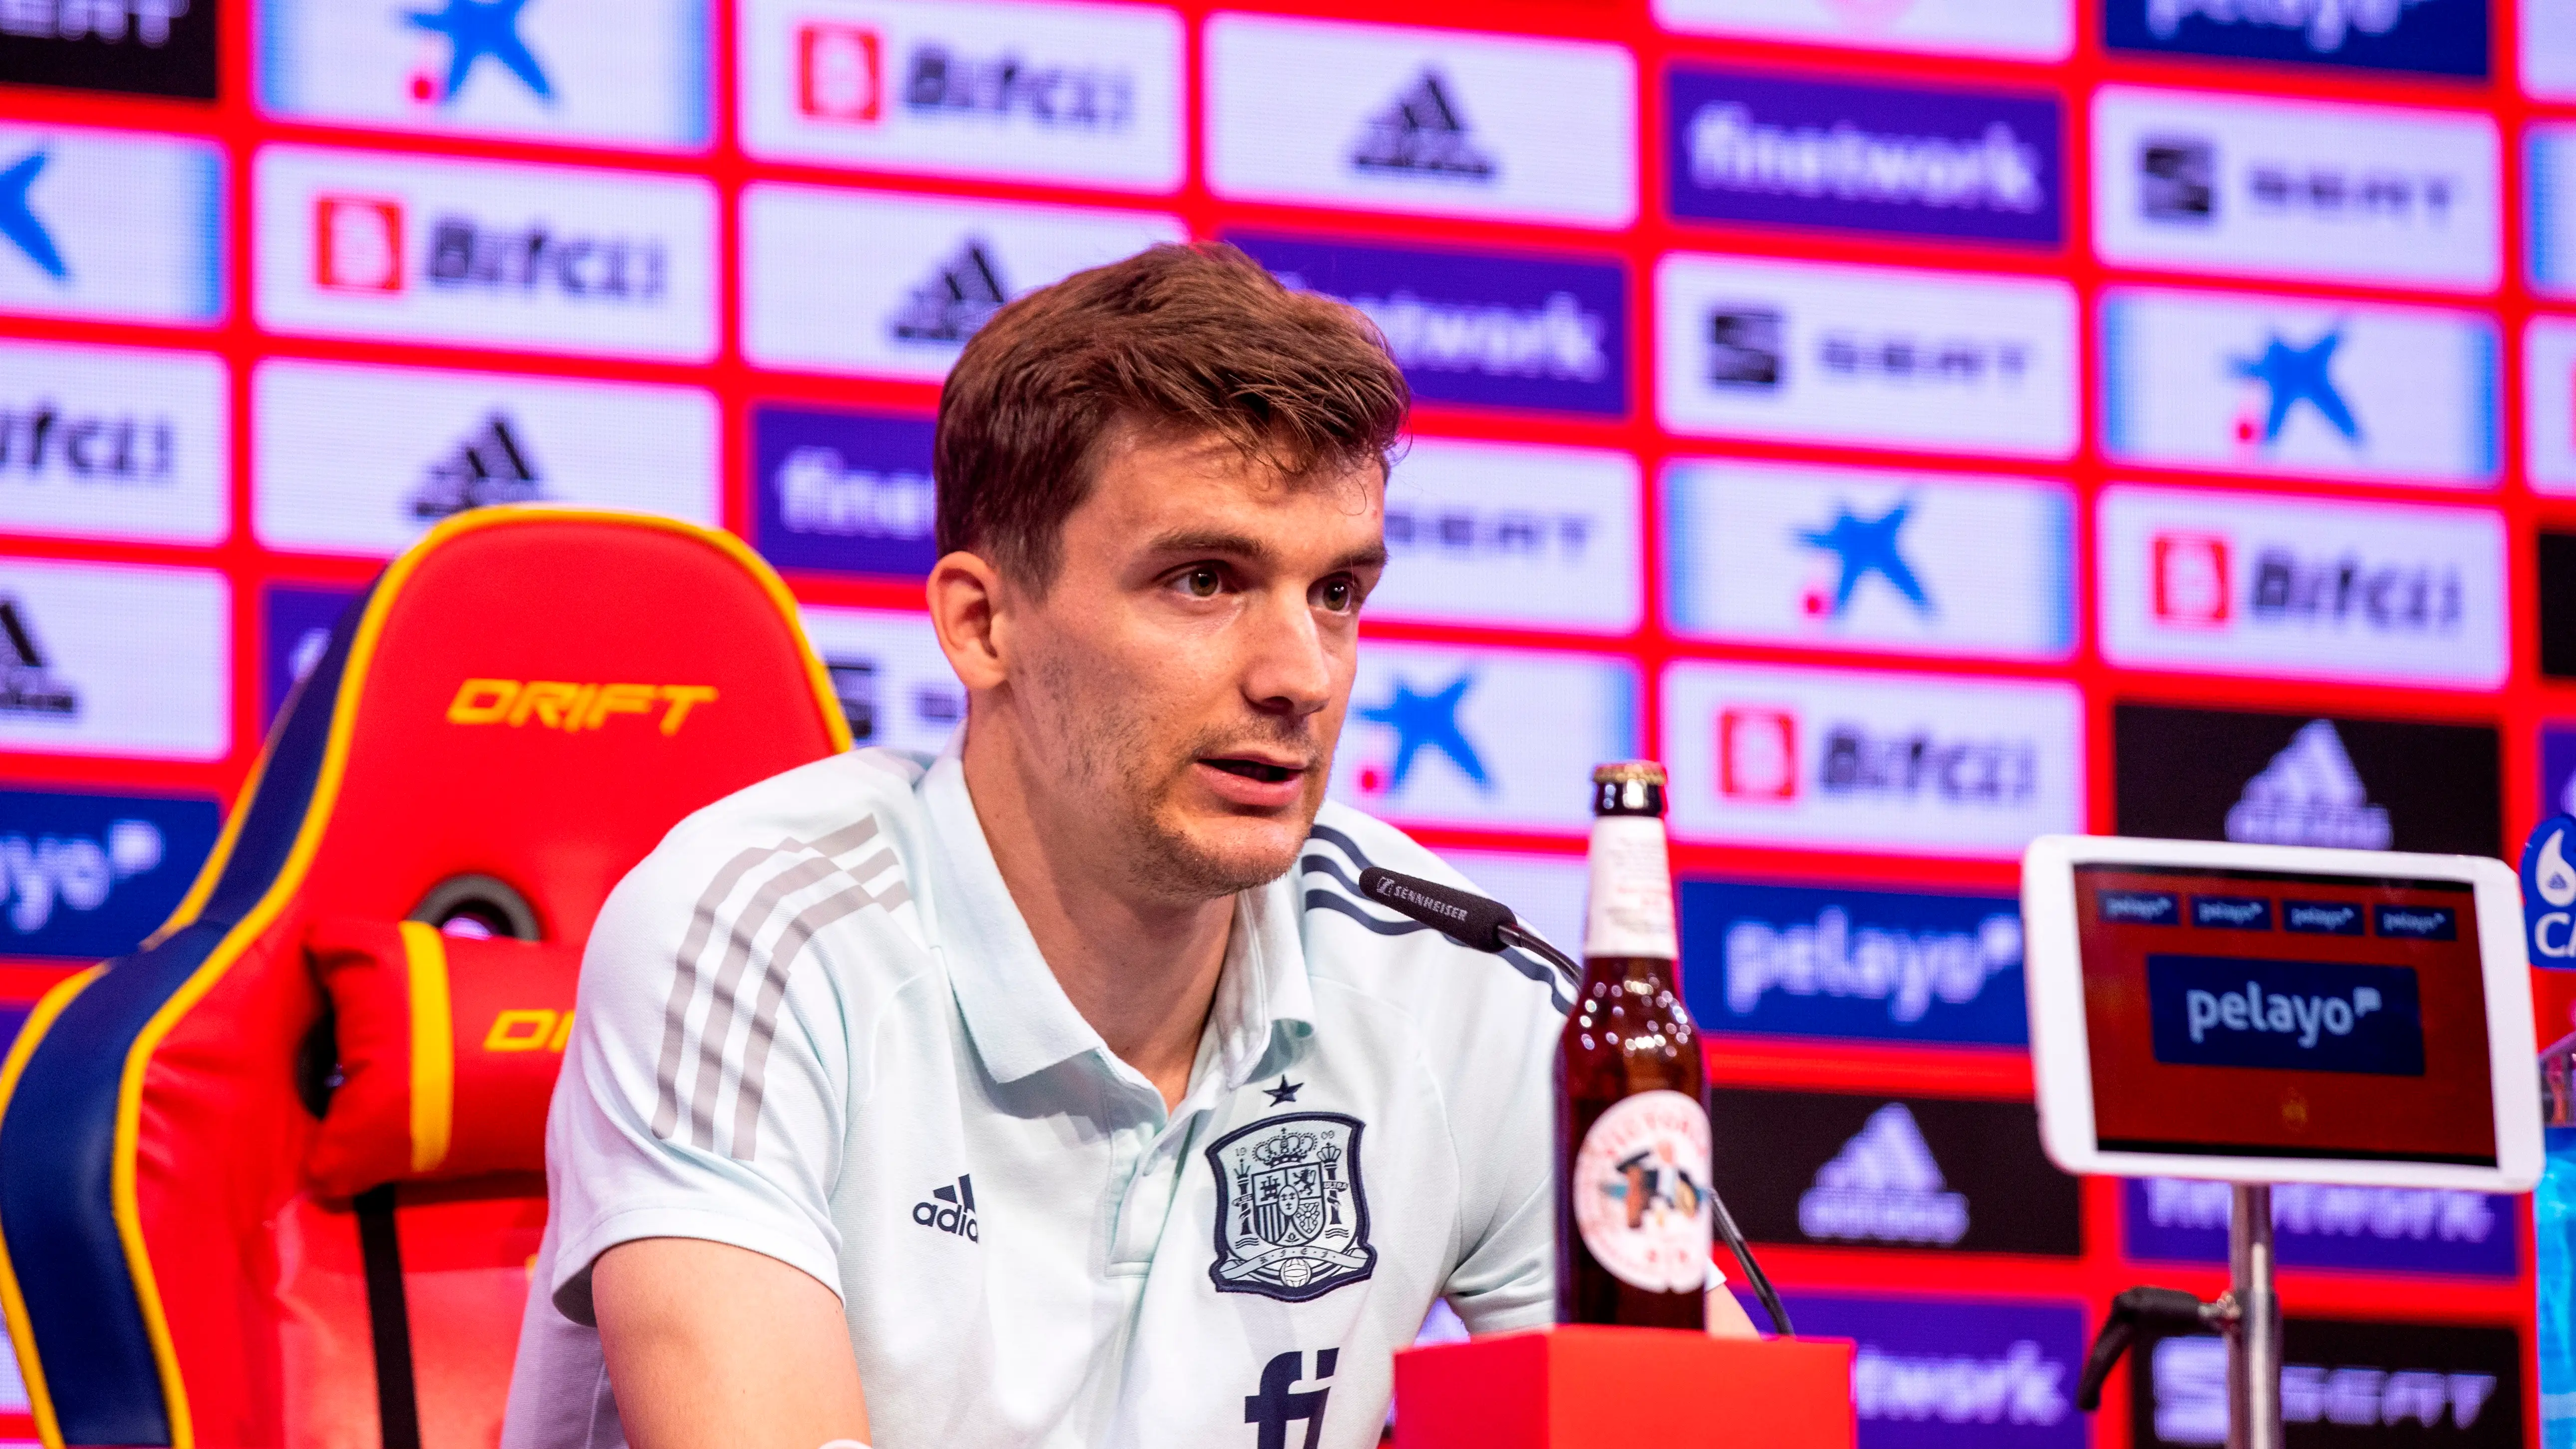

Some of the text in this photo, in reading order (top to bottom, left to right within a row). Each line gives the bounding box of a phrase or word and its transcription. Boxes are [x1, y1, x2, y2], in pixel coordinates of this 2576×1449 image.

[447, 678, 718, 735] DRIFT
[1395, 885, 1468, 921] SENNHEISER
[1725, 906, 1983, 1023] pelayo
[2186, 980, 2354, 1048] pelayo
